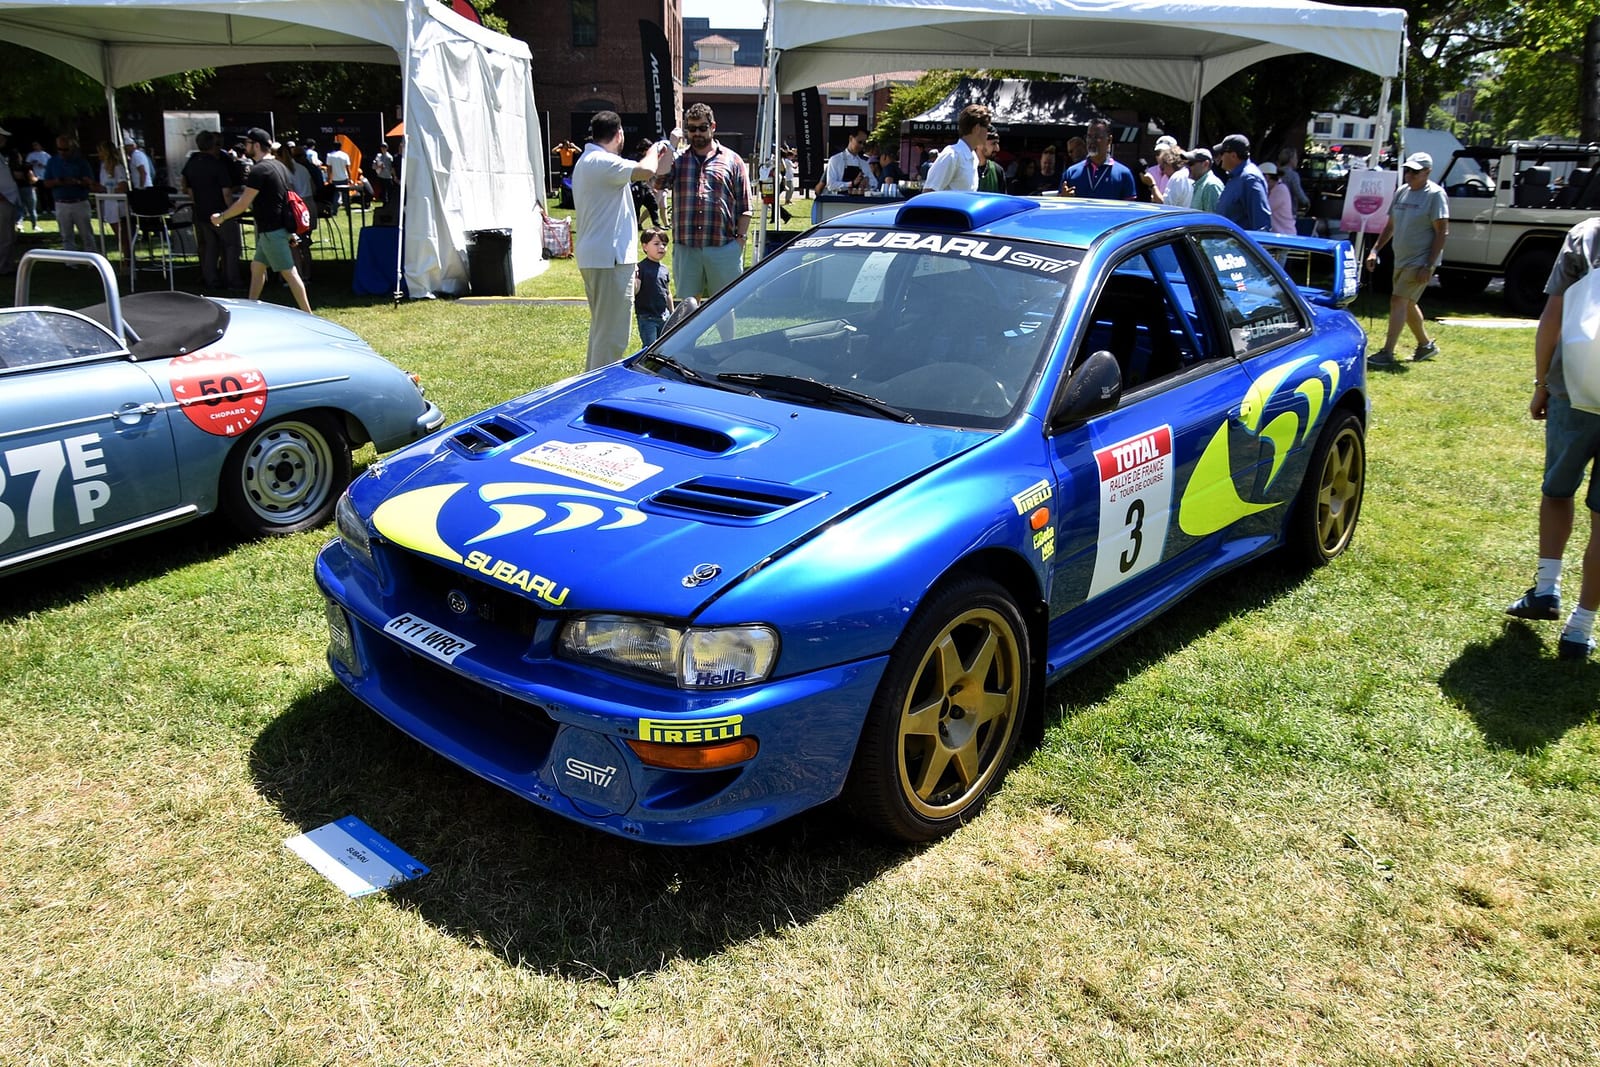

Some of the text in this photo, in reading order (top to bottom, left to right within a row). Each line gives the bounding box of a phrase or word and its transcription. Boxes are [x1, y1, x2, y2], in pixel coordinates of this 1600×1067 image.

[650, 52, 662, 134] McLaren
[833, 232, 1010, 262] SUBARU
[198, 376, 244, 406] 50
[210, 408, 246, 419] CHOPARD
[1111, 434, 1160, 473] TOTAL
[1109, 458, 1164, 493] RALLYE DE FRANCE
[1120, 485, 1134, 499] TOUR
[1135, 481, 1142, 492] DE
[1011, 478, 1052, 516] PIRELLI
[1119, 498, 1145, 574] 3
[463, 550, 570, 606] SUBARU
[421, 630, 466, 656] WRC
[696, 668, 746, 685] Hella
[639, 714, 743, 743] PIRELLI
[346, 847, 370, 864] SUBARU
